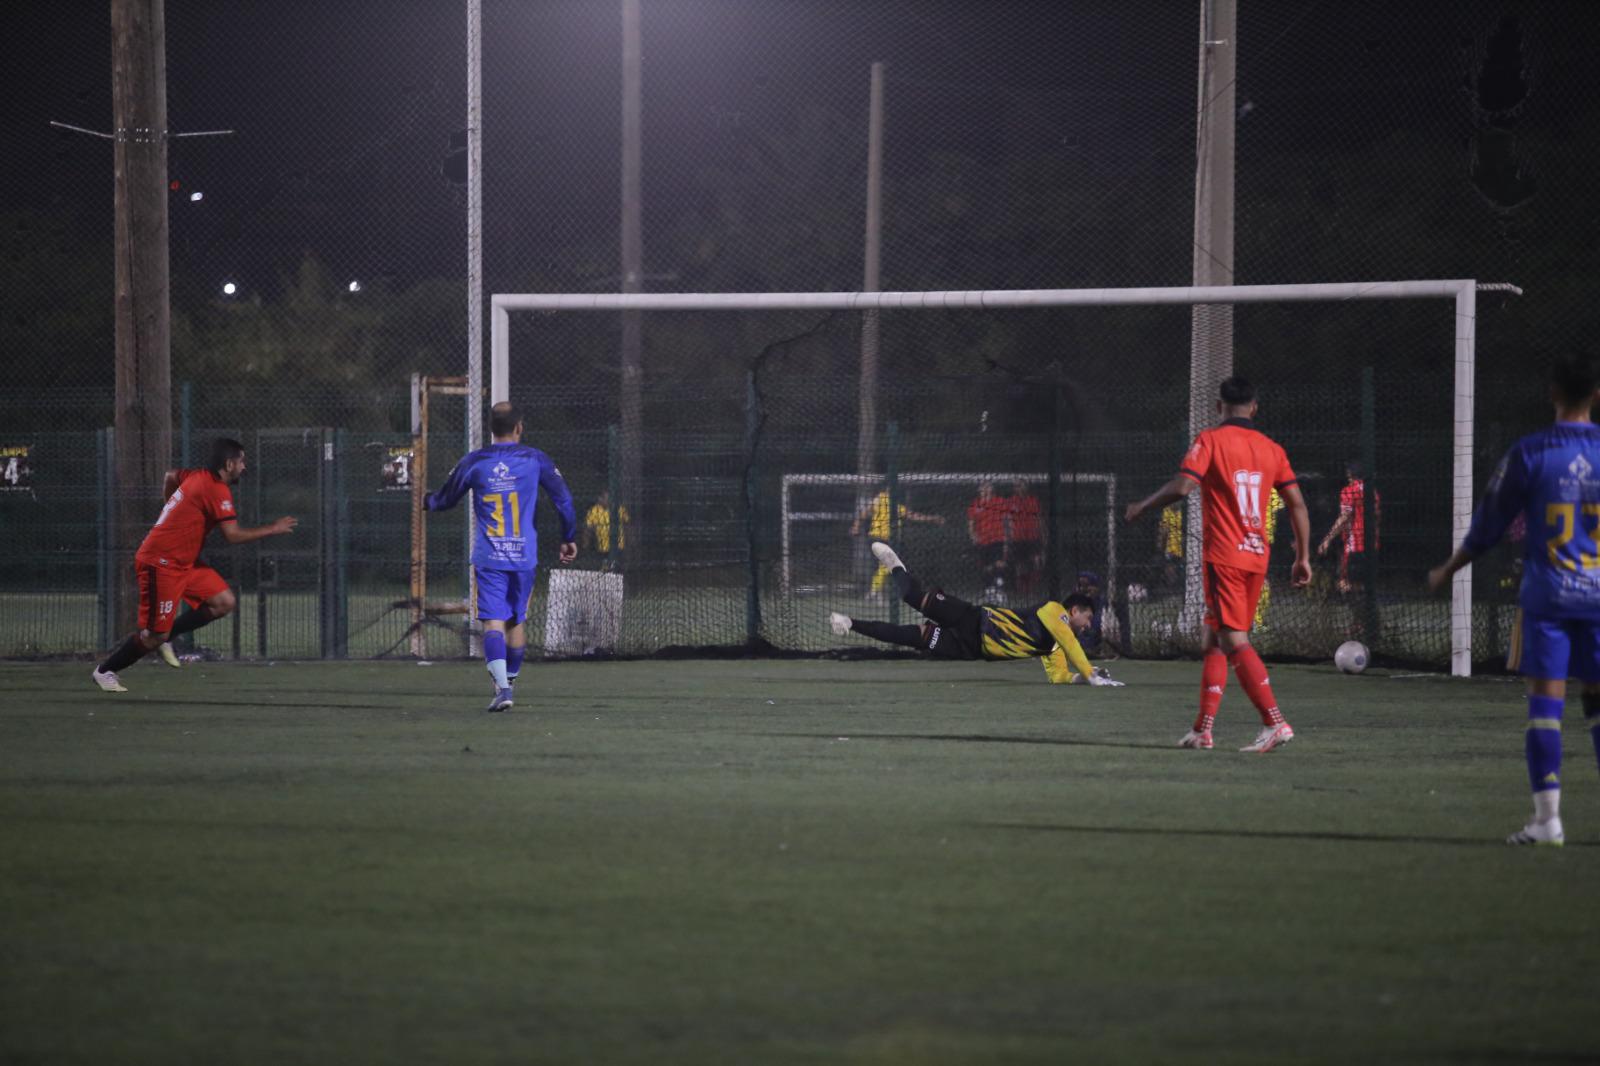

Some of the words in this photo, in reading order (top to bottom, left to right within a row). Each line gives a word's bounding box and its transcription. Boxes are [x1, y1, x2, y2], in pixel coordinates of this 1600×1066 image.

[4, 457, 18, 485] 4
[396, 456, 408, 484] 3
[1234, 470, 1262, 527] 11
[482, 491, 520, 537] 31
[159, 600, 173, 614] 18
[929, 627, 941, 649] CASTRO
